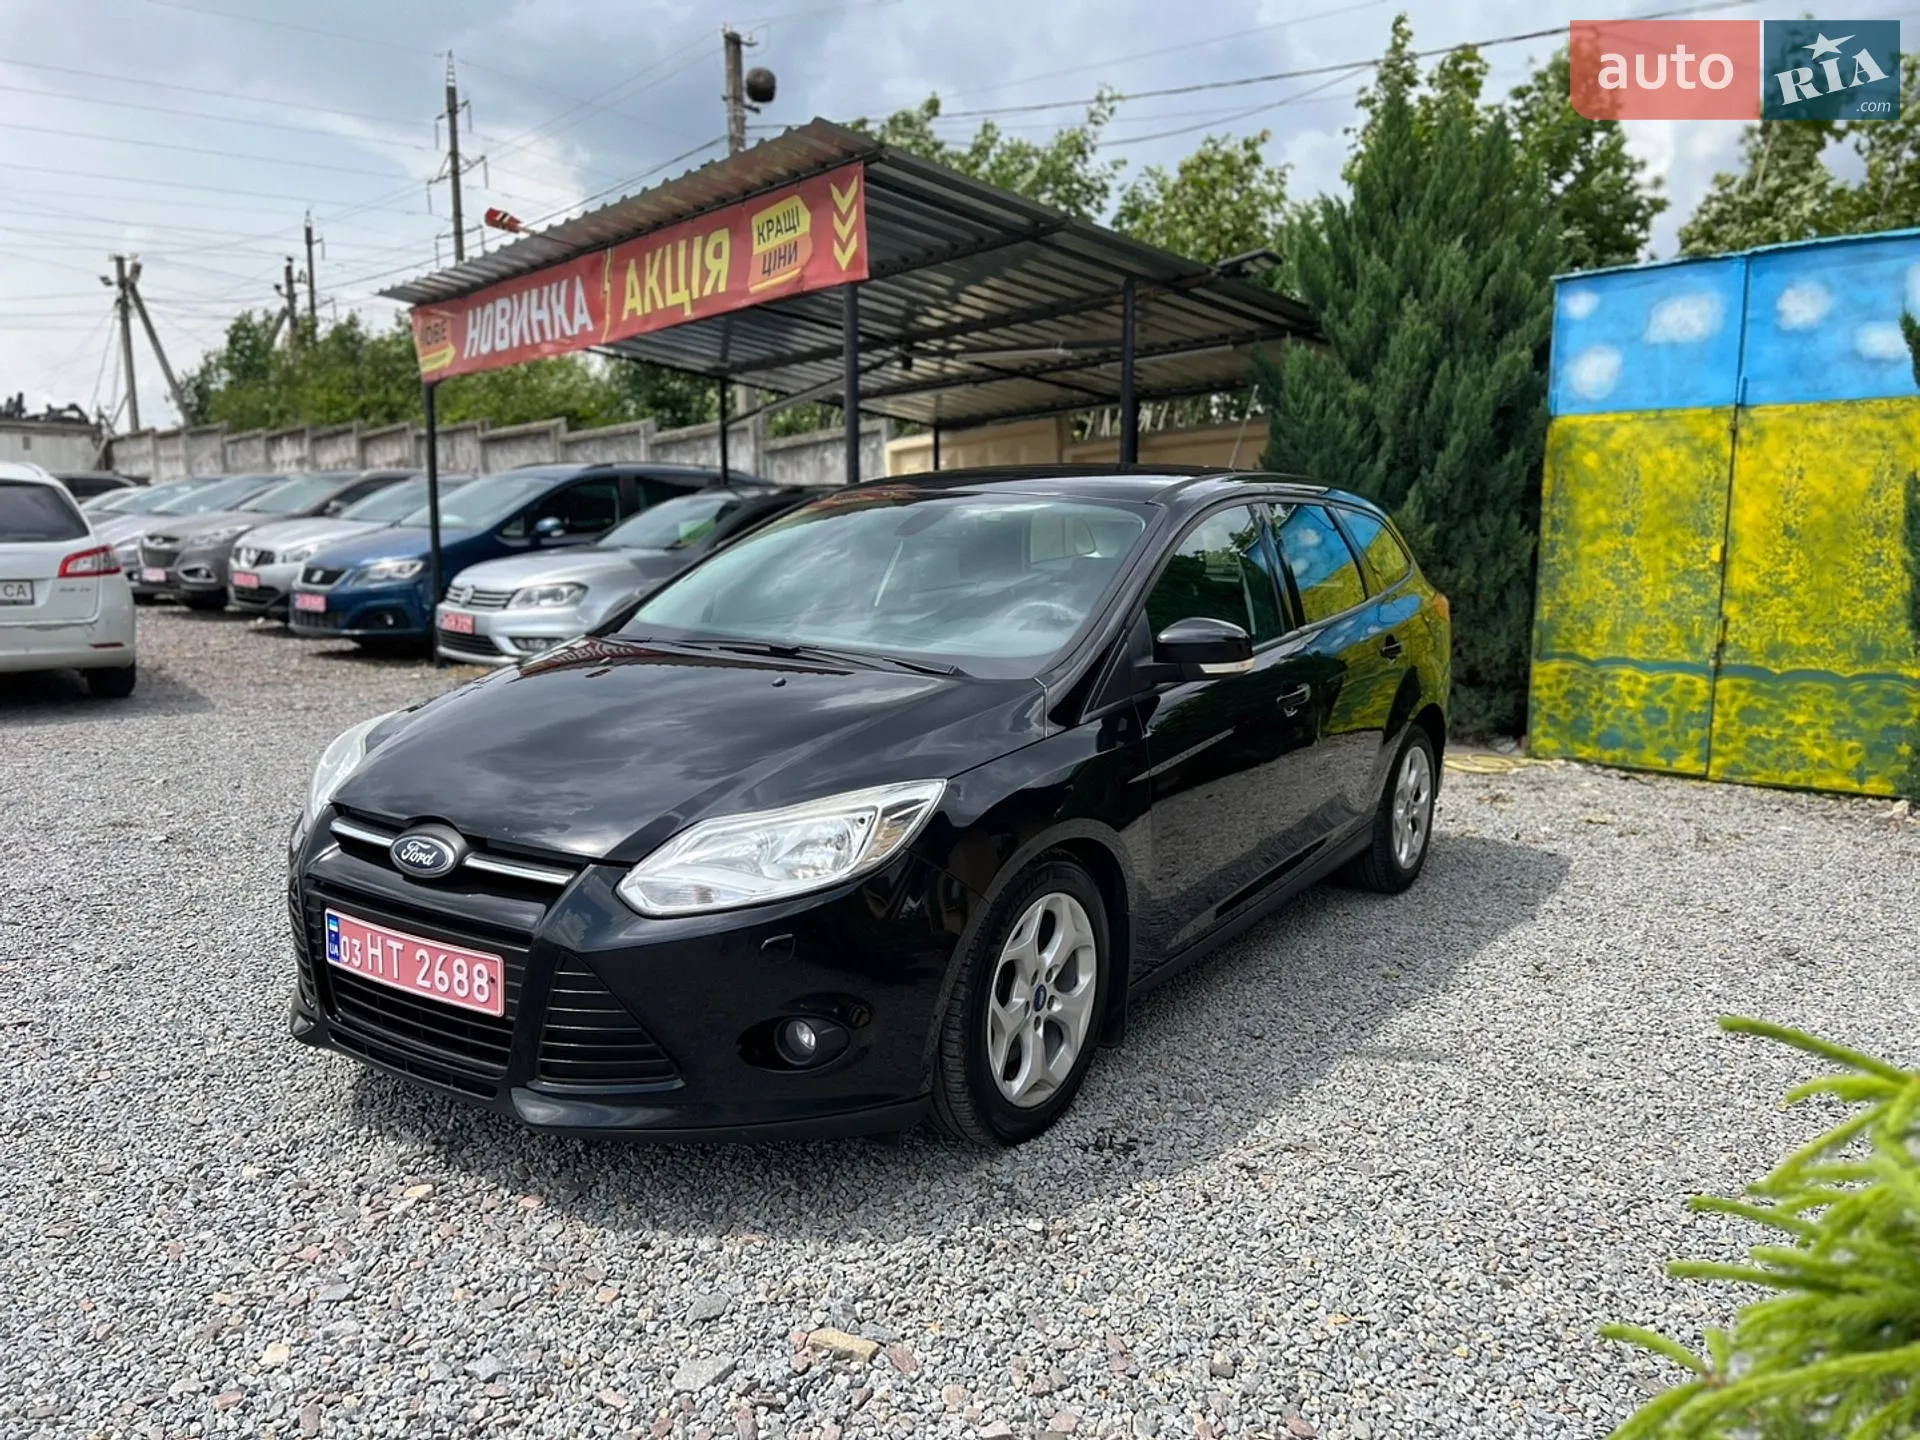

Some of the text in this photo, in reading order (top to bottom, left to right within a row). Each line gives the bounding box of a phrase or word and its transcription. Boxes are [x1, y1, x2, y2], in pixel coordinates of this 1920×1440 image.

[756, 205, 801, 246] КРАЩІ
[622, 229, 730, 320] АКЦІЯ
[762, 240, 798, 277] ЦІНИ
[463, 277, 594, 360] НОВИНКА
[401, 840, 438, 867] Ford
[415, 949, 490, 1003] 2688
